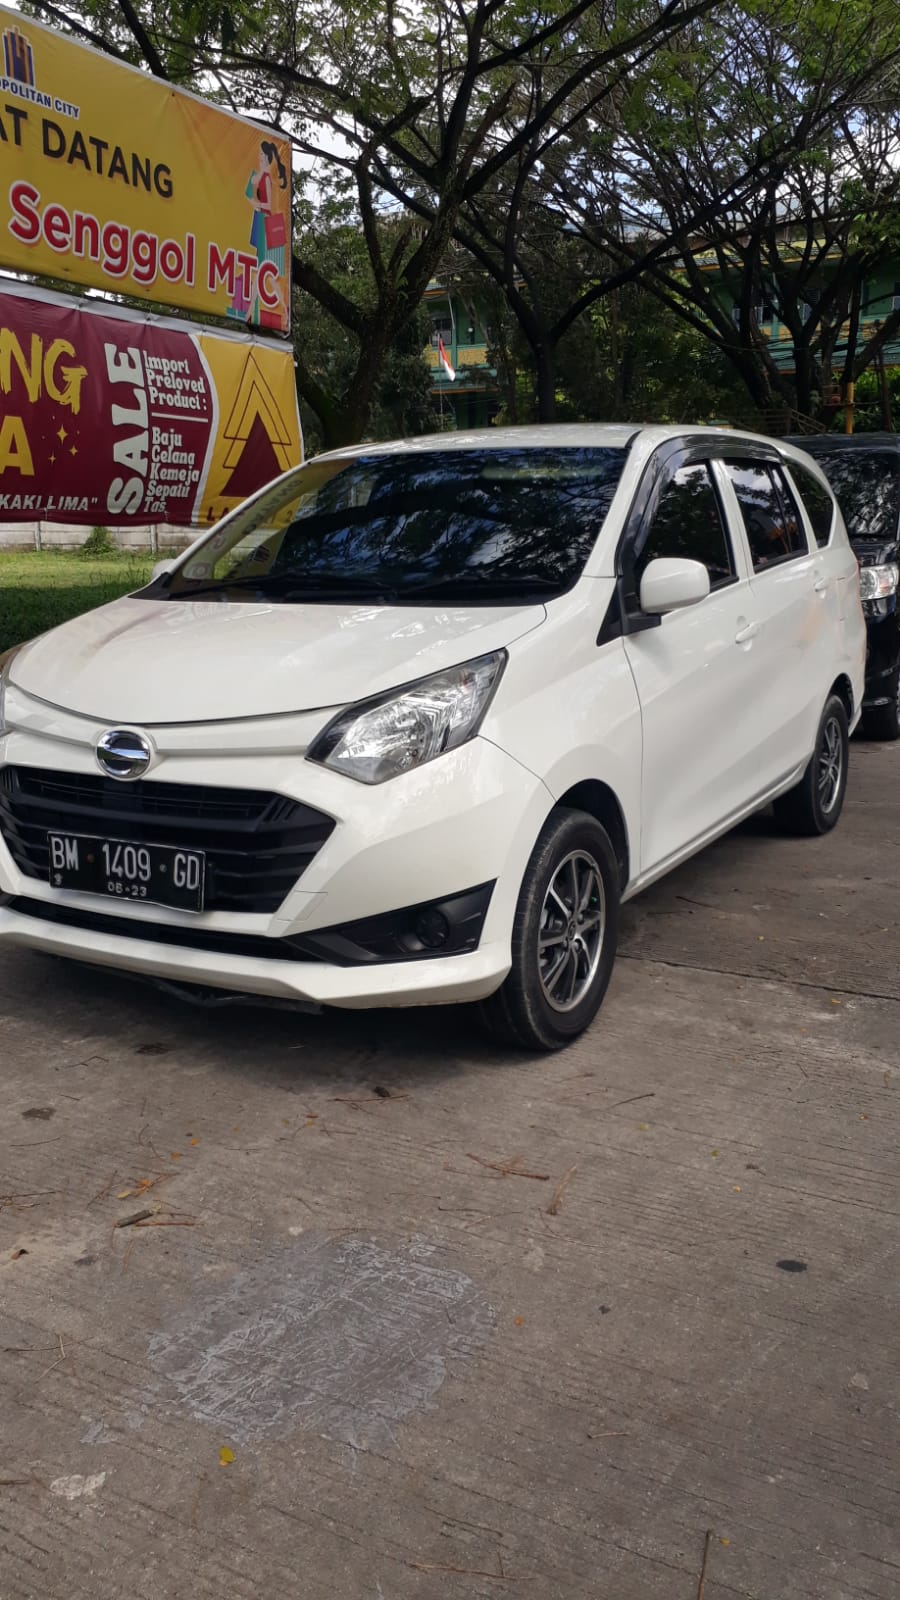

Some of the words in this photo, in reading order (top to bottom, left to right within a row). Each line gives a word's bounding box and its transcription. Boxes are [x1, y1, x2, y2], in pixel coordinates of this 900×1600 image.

[0, 78, 51, 107] POLITAN
[55, 99, 80, 118] CITY
[42, 118, 173, 198] DATANG
[9, 181, 196, 287] Senggol
[208, 243, 280, 308] MTC
[143, 350, 190, 375] Import
[146, 369, 206, 394] Preloved
[104, 342, 149, 515] SALE
[152, 427, 183, 447] Baju
[151, 445, 195, 465] Celana
[150, 463, 200, 485] Kemeja
[146, 480, 191, 501] Sepatu
[143, 496, 167, 513] Tas
[51, 836, 79, 871] BM
[102, 843, 151, 881] 1409
[173, 853, 200, 890] GD
